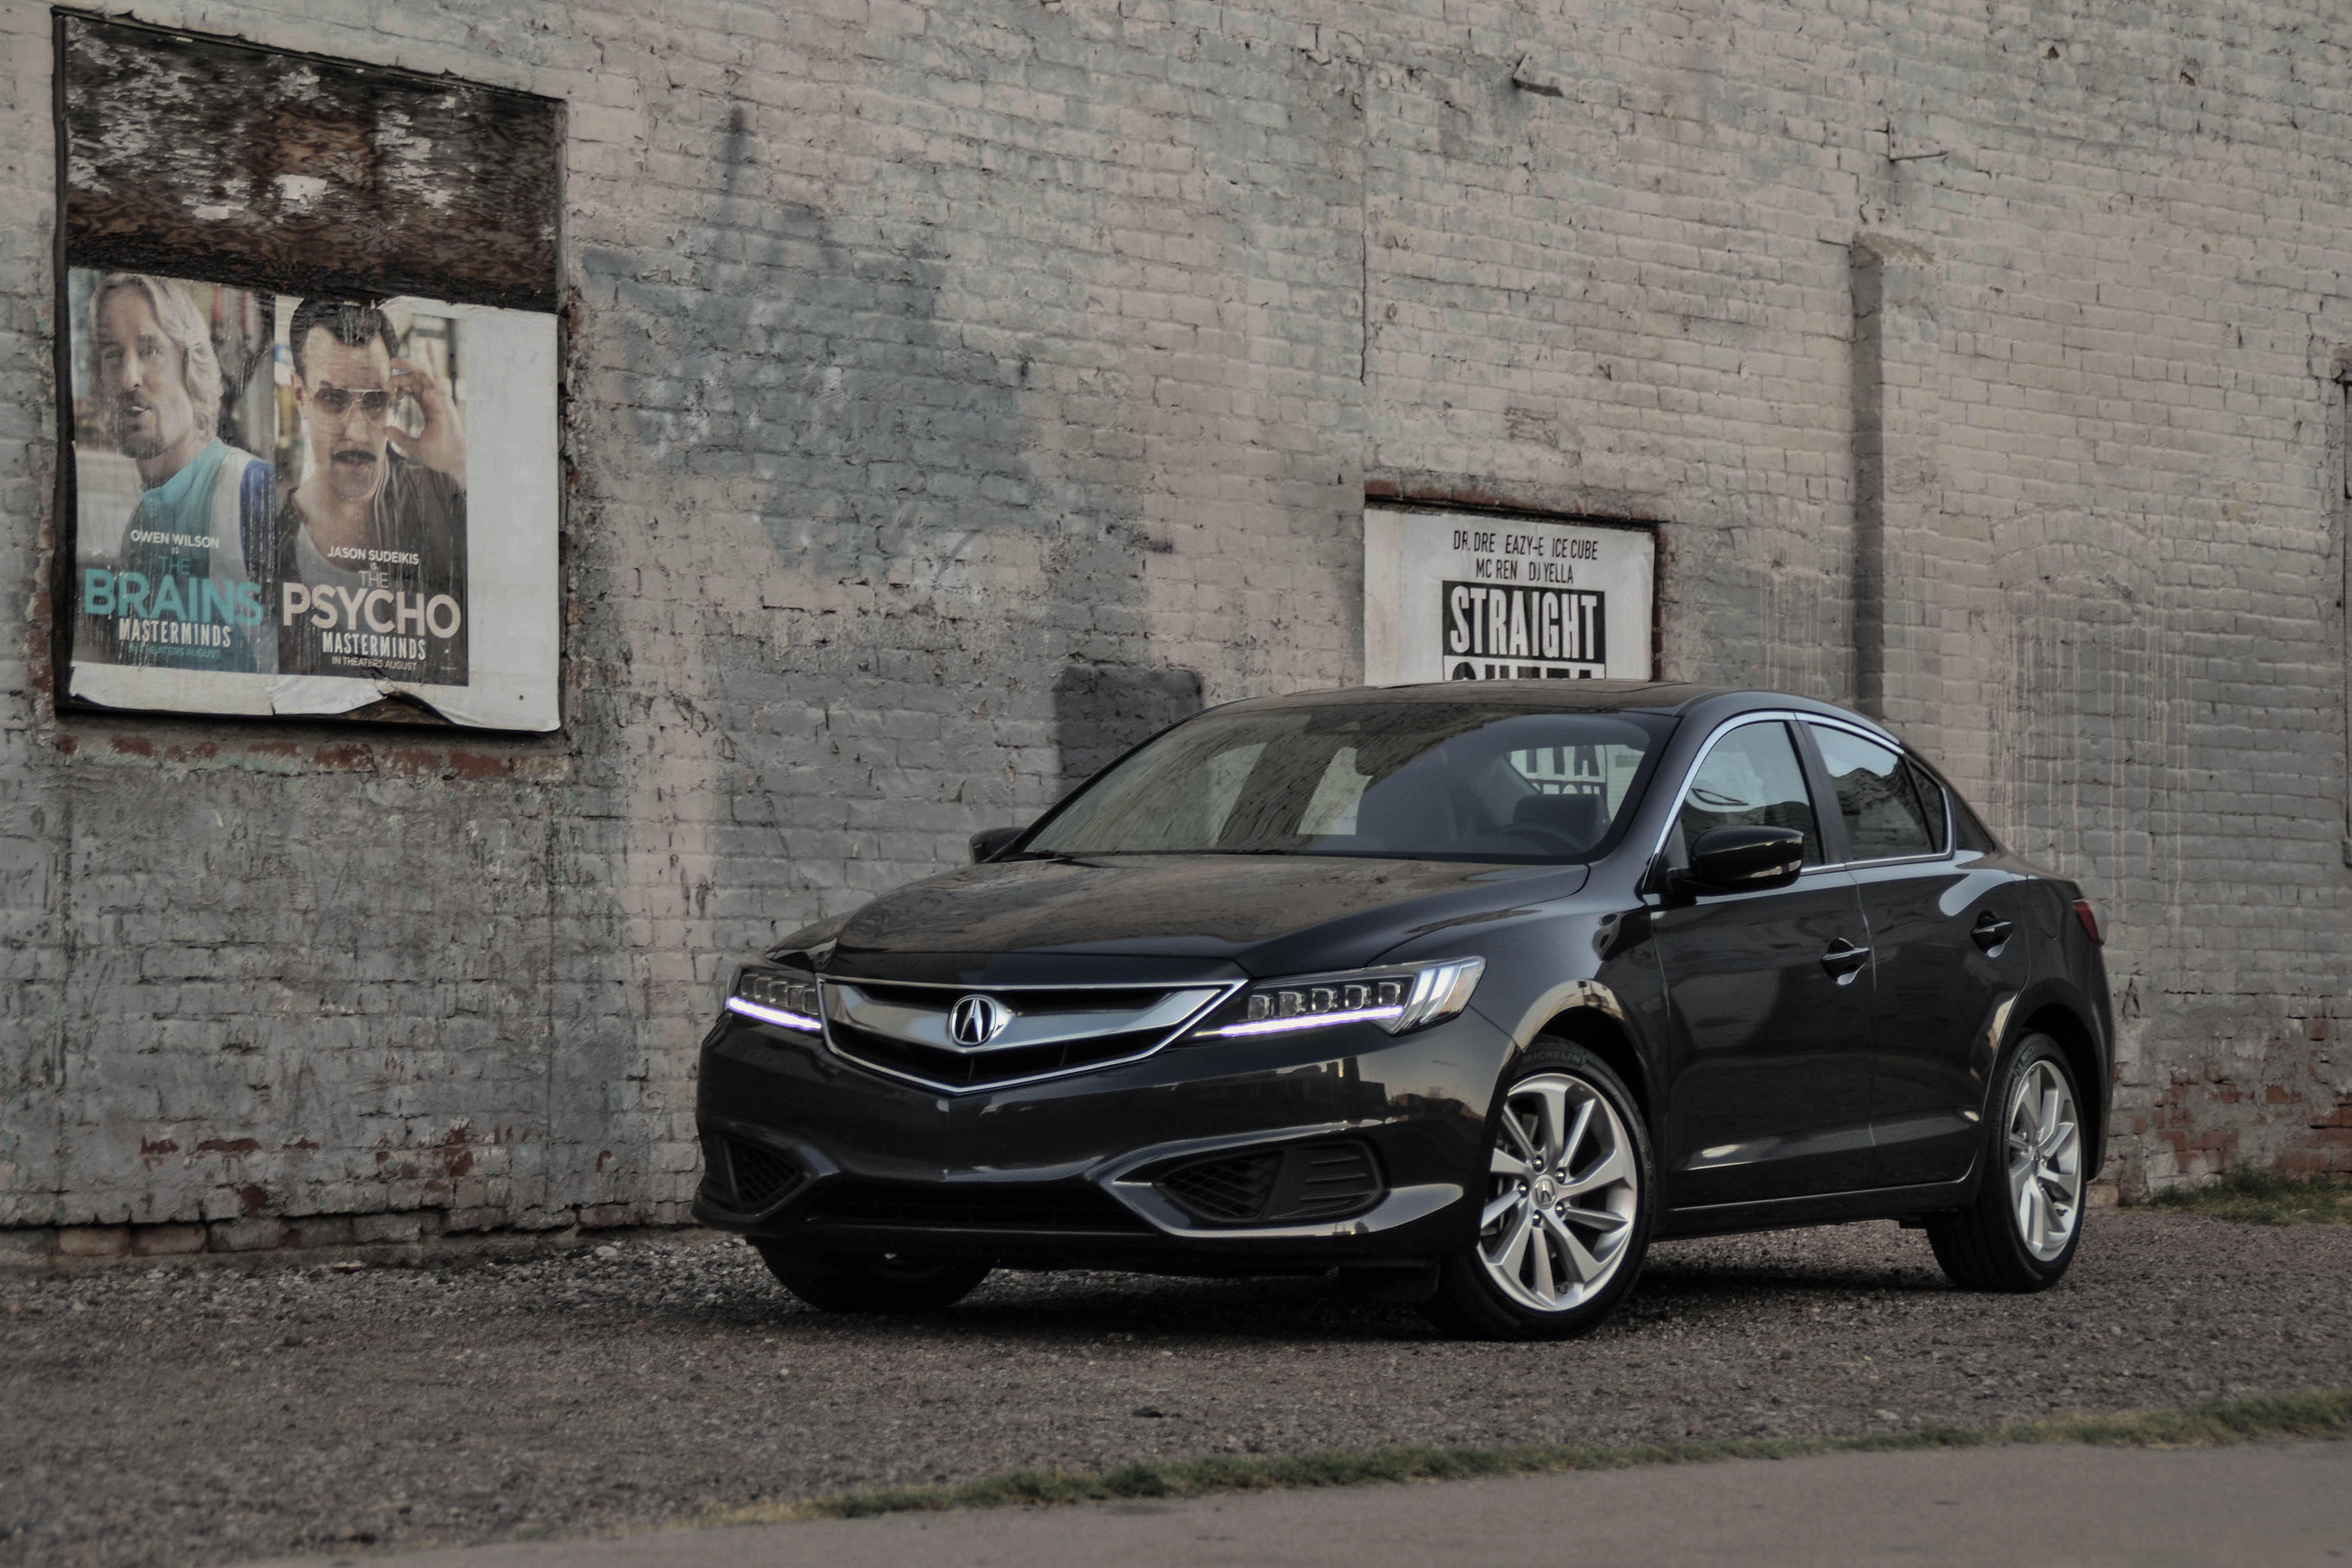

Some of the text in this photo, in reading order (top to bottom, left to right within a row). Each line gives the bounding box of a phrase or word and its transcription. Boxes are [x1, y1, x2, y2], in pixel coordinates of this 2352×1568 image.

[131, 530, 219, 549] OWEN WILSON
[1474, 532, 1496, 553] DRE
[1505, 535, 1544, 556] EAZY-E
[1552, 537, 1569, 558] ICE
[1571, 539, 1598, 560] CUBE
[159, 555, 192, 575] THE
[327, 546, 420, 565] JASON SUDEIKIS
[358, 570, 389, 589] THE
[1476, 558, 1574, 584] MC REN DJ YELLA
[84, 568, 264, 627] BRAINS
[282, 582, 462, 639] PSYCHO
[118, 618, 233, 648] MASTERMINDS
[1450, 585, 1598, 660] STRAIGHT
[322, 631, 426, 660] MASTERMINDS
[384, 660, 418, 671] AUGUST
